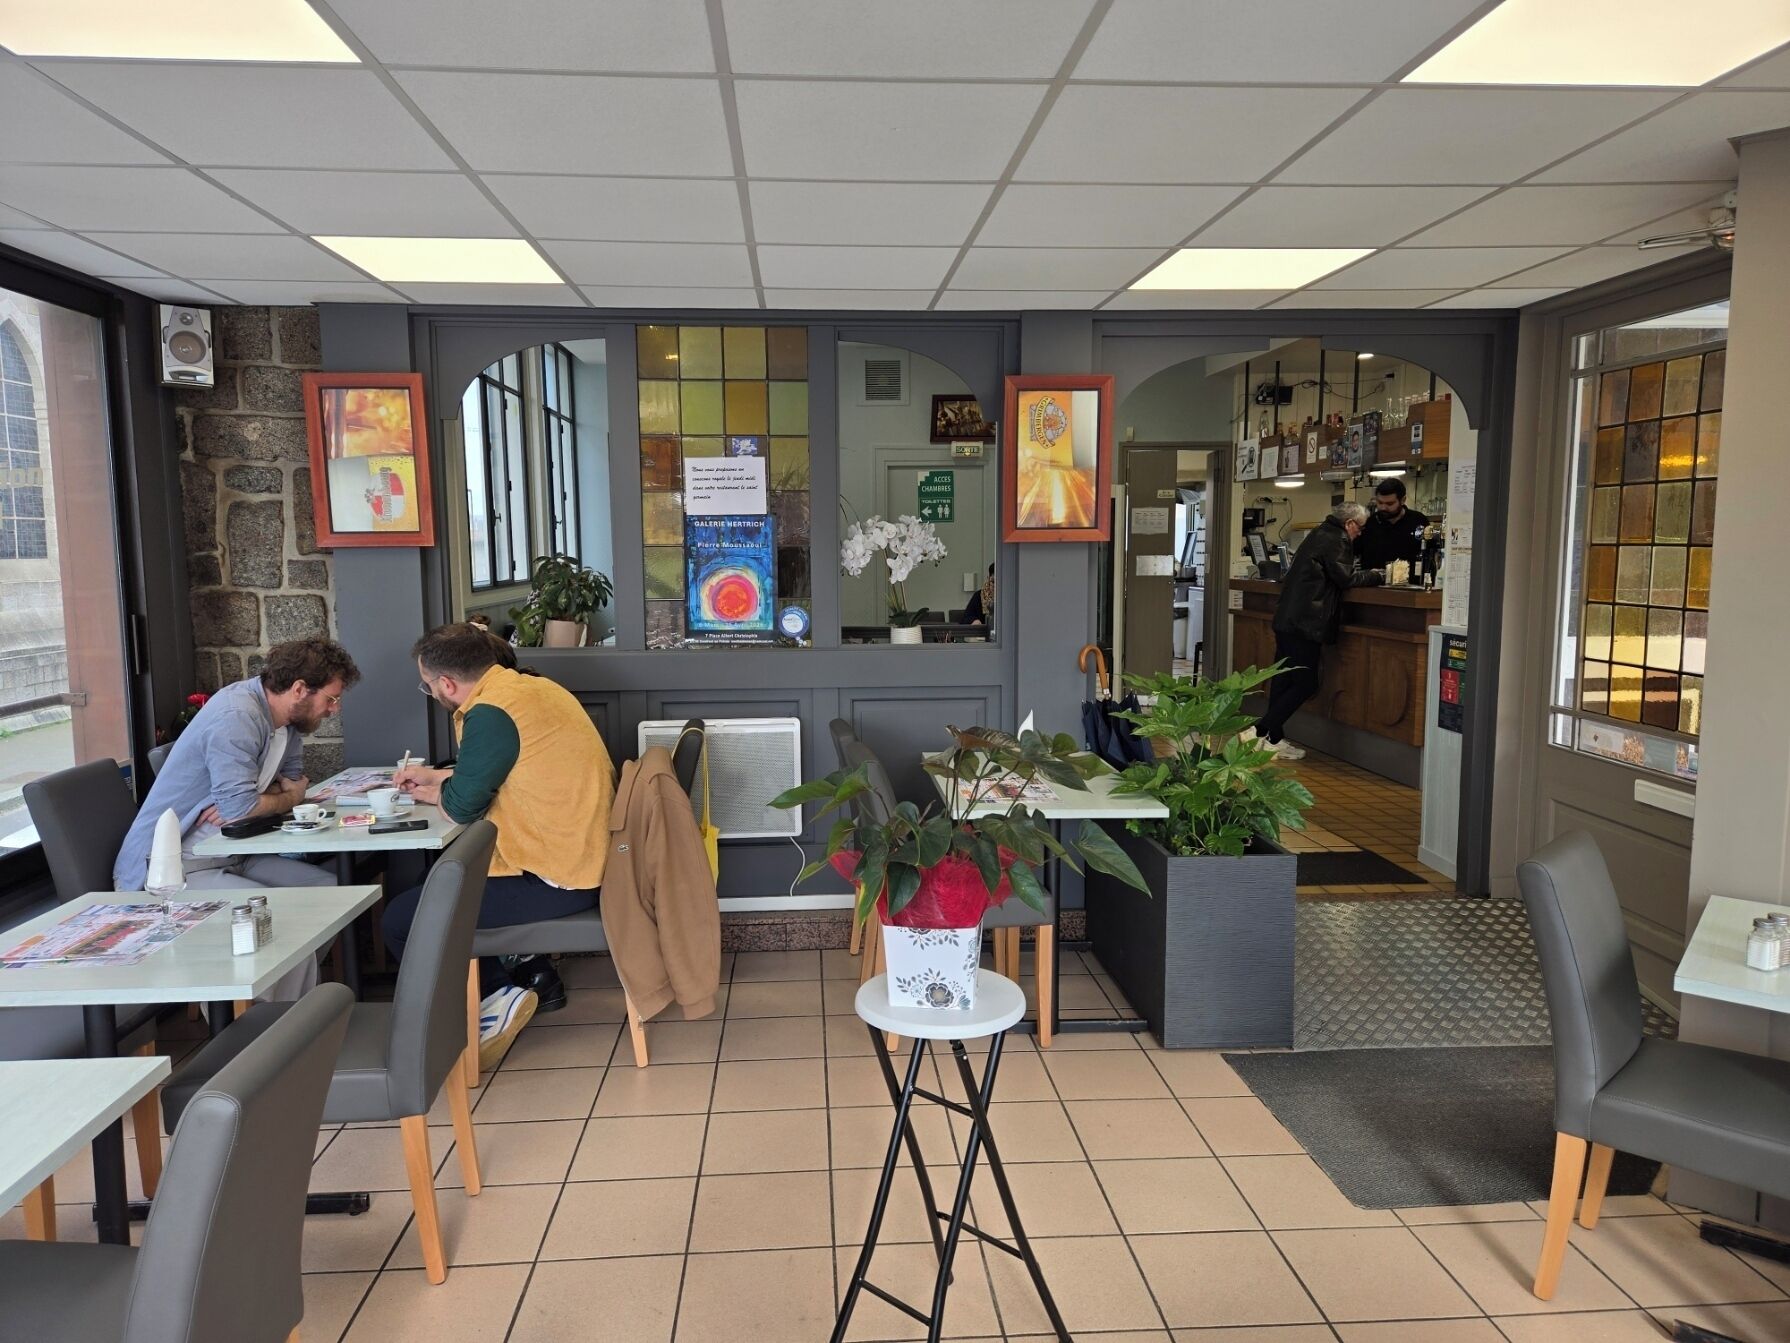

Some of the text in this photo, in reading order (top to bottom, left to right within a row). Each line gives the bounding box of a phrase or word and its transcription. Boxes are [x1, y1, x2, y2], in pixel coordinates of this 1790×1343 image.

[934, 475, 951, 483] ACCES
[694, 520, 765, 528] GALERIE HERTRICH
